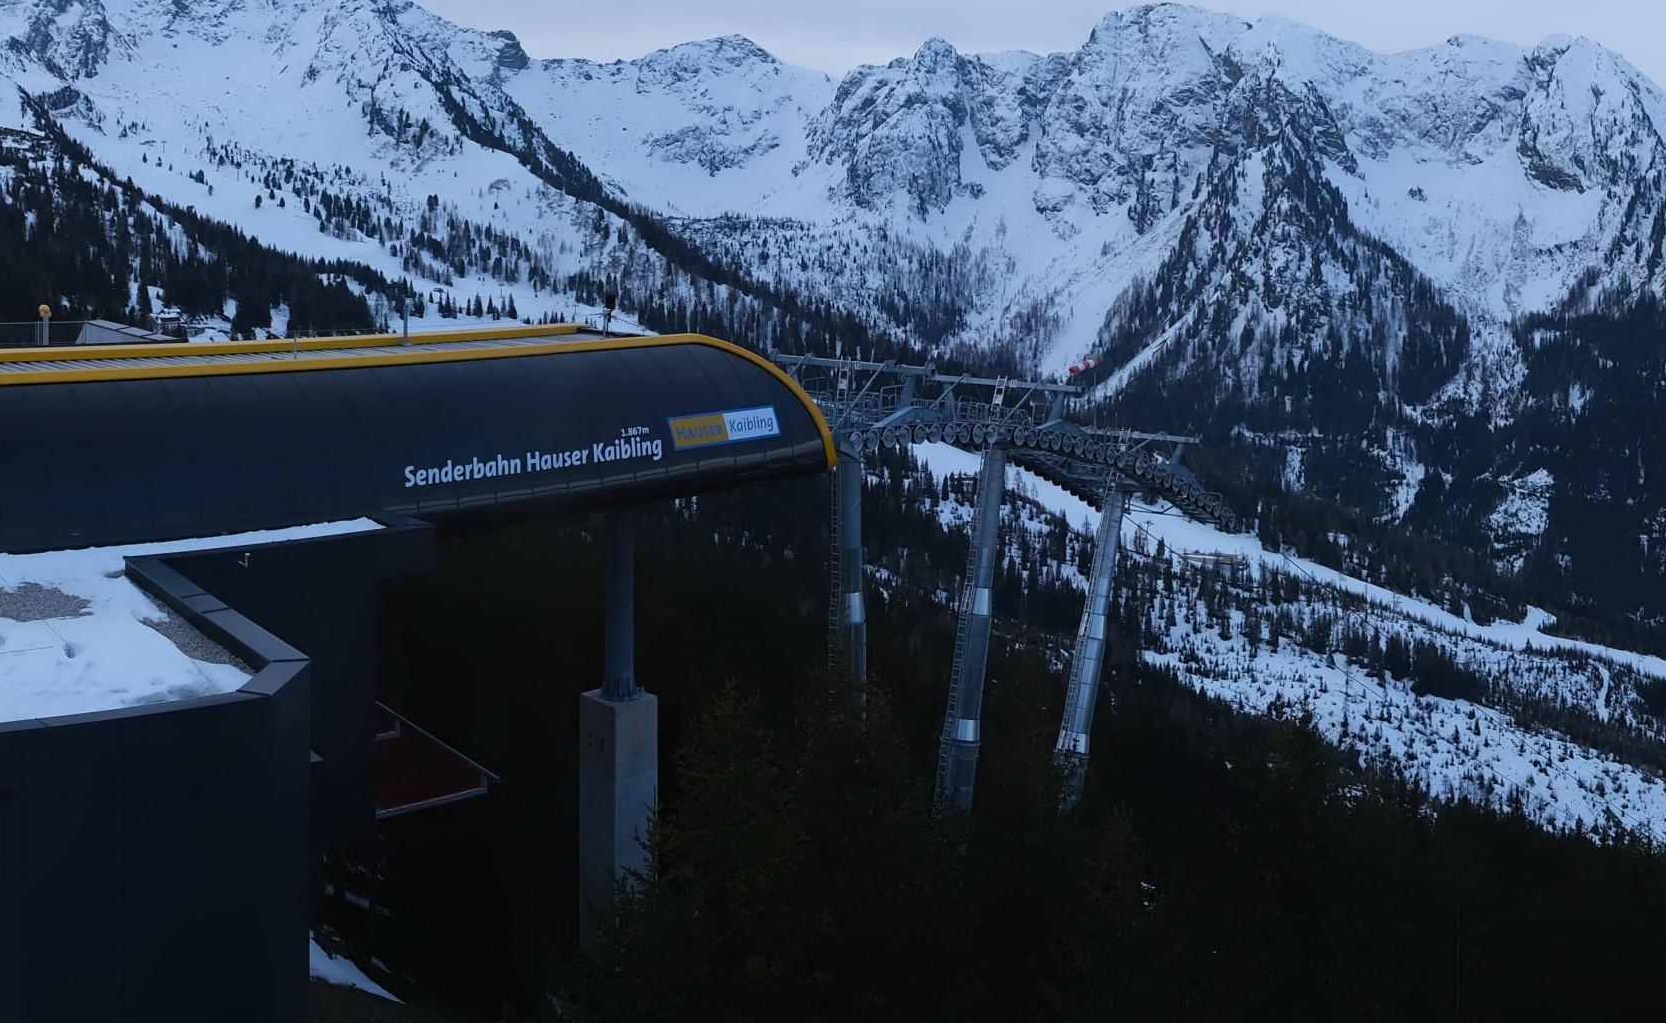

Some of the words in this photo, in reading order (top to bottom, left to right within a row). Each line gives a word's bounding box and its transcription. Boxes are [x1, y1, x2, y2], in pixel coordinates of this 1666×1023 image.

[620, 426, 650, 437] 1.867m
[675, 423, 723, 441] HAUSER
[729, 415, 774, 433] Kaibling
[404, 453, 522, 488] Senderbahn
[525, 447, 589, 473] Hauser
[593, 437, 663, 464] Kaibling
